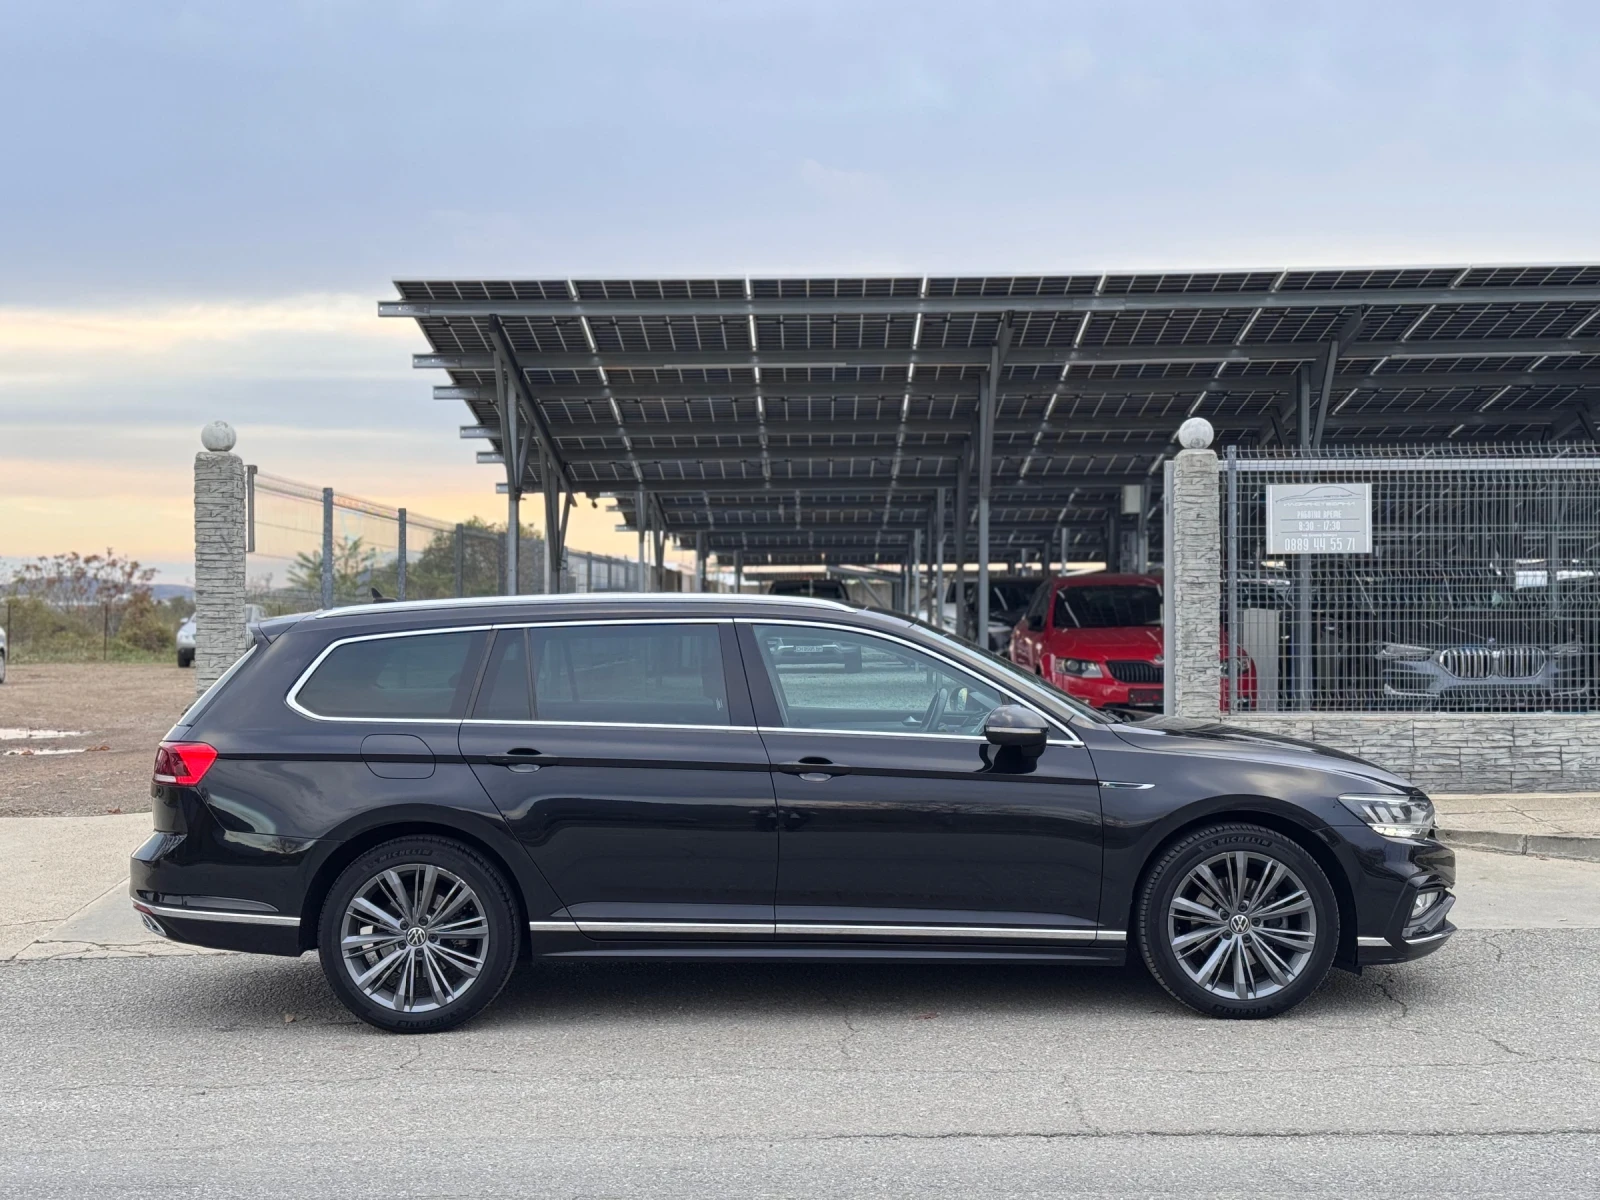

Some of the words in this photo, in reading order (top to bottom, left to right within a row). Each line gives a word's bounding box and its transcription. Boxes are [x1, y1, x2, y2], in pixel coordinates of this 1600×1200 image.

[1298, 521, 1314, 531] 8:30
[1323, 521, 1340, 531] 17:30
[1284, 538, 1309, 551] 0889
[1313, 538, 1326, 551] 44
[1330, 538, 1343, 551] 55
[1347, 538, 1356, 551] 71
[1217, 836, 1270, 847] MICHELIN
[379, 849, 430, 862] MICHELIN
